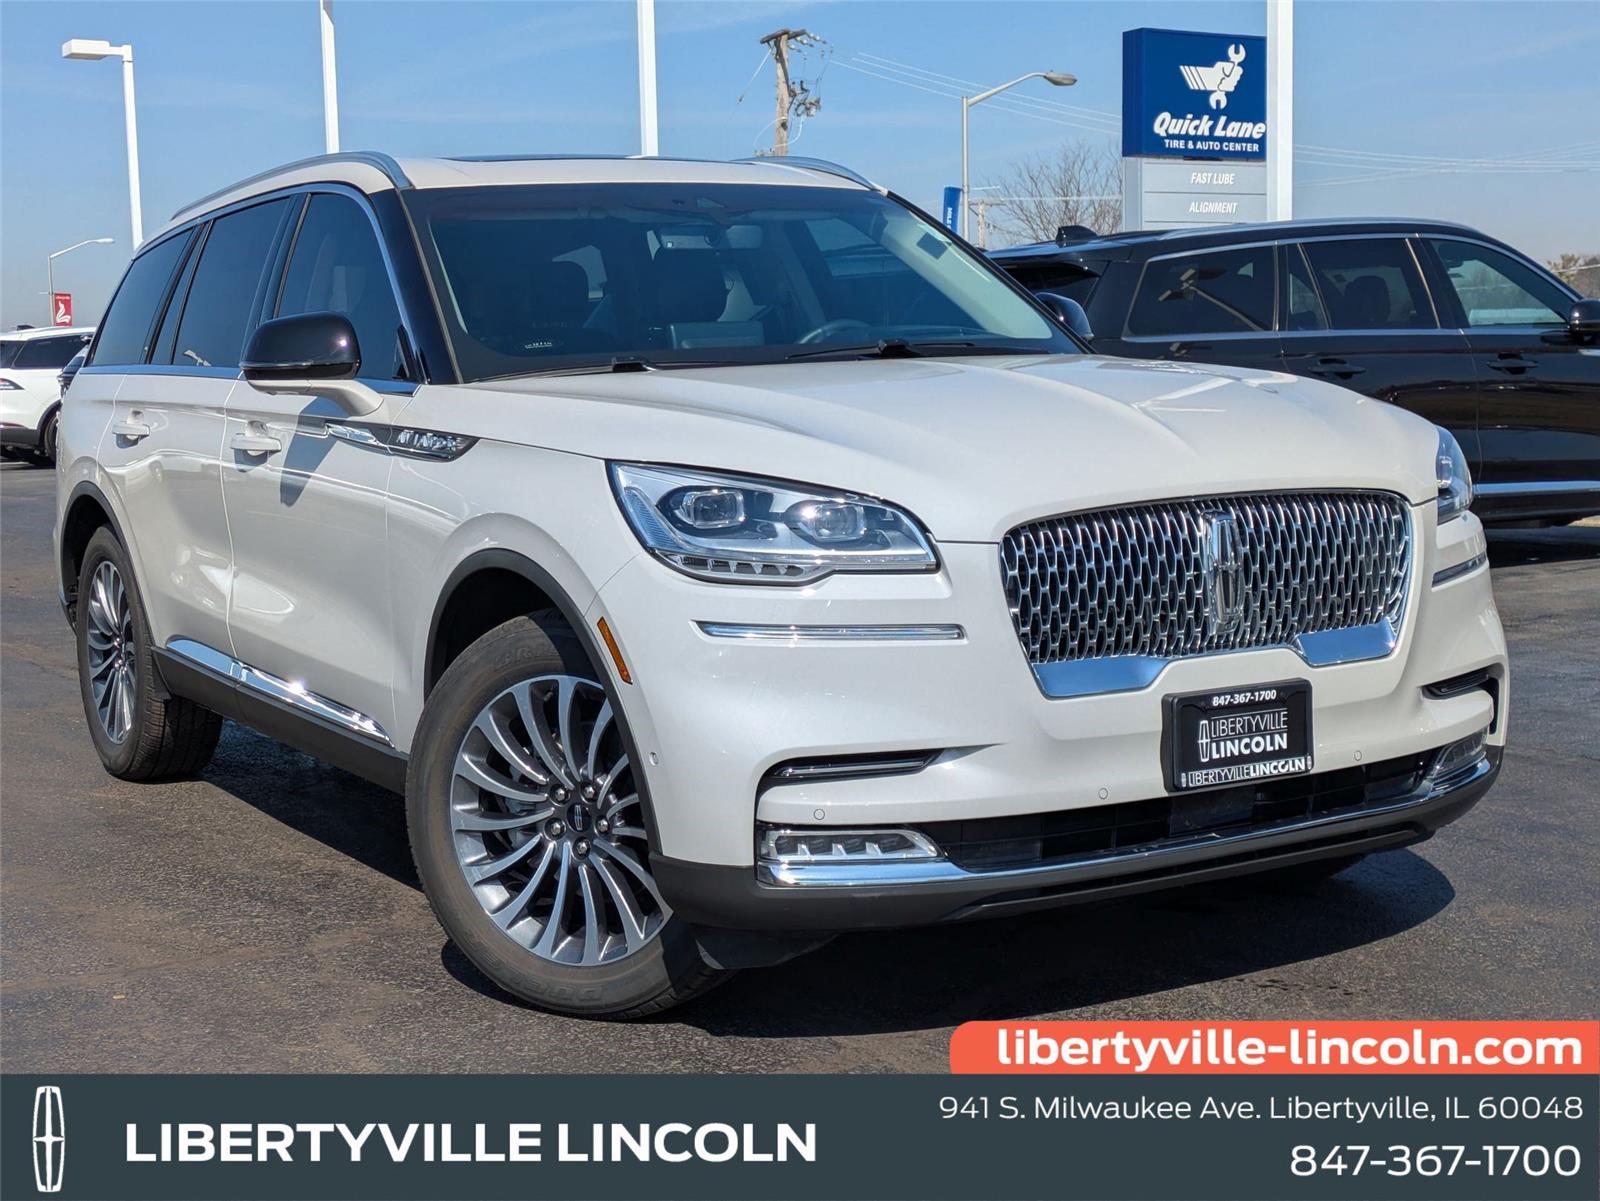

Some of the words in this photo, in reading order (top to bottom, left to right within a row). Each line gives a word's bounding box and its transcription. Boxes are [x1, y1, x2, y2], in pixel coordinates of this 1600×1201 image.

[1153, 111, 1214, 136] Quick
[1214, 115, 1266, 139] Lane
[1164, 139, 1185, 149] TIRE
[1187, 140, 1194, 149] &
[1196, 141, 1220, 151] AUTO
[1222, 142, 1259, 152] CENTER
[1191, 172, 1212, 184] FAST
[1213, 173, 1235, 185] LUBE
[1189, 201, 1238, 214] ALIGNMENT
[1212, 689, 1277, 707] 847-367-1700
[1211, 711, 1288, 738] LIBERTYVILLE
[1212, 733, 1287, 759] LINCOLN
